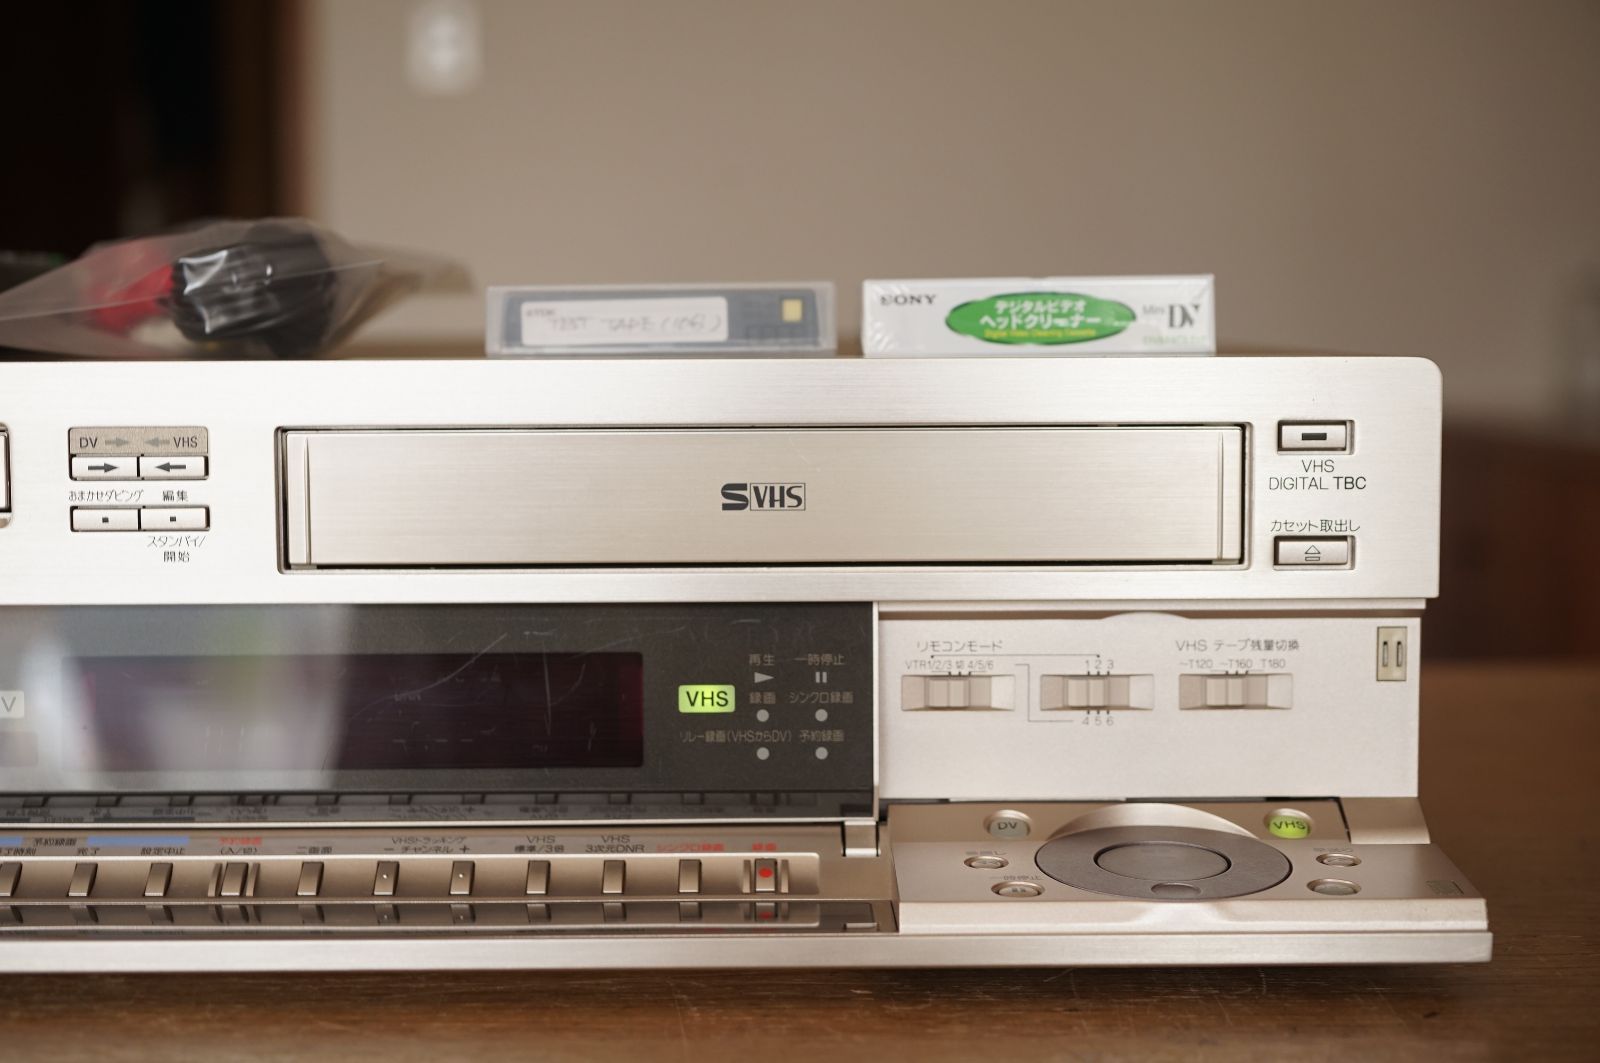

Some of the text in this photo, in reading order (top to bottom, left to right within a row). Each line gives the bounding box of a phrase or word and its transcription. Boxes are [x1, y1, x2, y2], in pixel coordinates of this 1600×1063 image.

[995, 300, 1086, 314] デジタルビデオ
[980, 314, 1101, 330] ヘッドクリーナー
[1168, 303, 1201, 329] DV
[79, 436, 98, 449] DV
[173, 436, 198, 449] VHS
[1301, 459, 1335, 473] VHS
[1268, 476, 1367, 490] DIGITAL TBC
[68, 489, 145, 502] おまかせダビング
[162, 489, 189, 502] 編集
[1270, 519, 1361, 533] カセット取出し
[163, 550, 190, 563] 開始
[916, 640, 1003, 652] リモコンモード
[1175, 640, 1208, 651] VHS
[749, 653, 775, 666] 再生
[794, 653, 845, 666] 一時停止
[1261, 659, 1286, 669] T180
[686, 690, 729, 707] VHS
[997, 821, 1018, 831] DV
[1272, 819, 1306, 831] VHS
[526, 835, 556, 844] VHS
[601, 834, 631, 843] VHS
